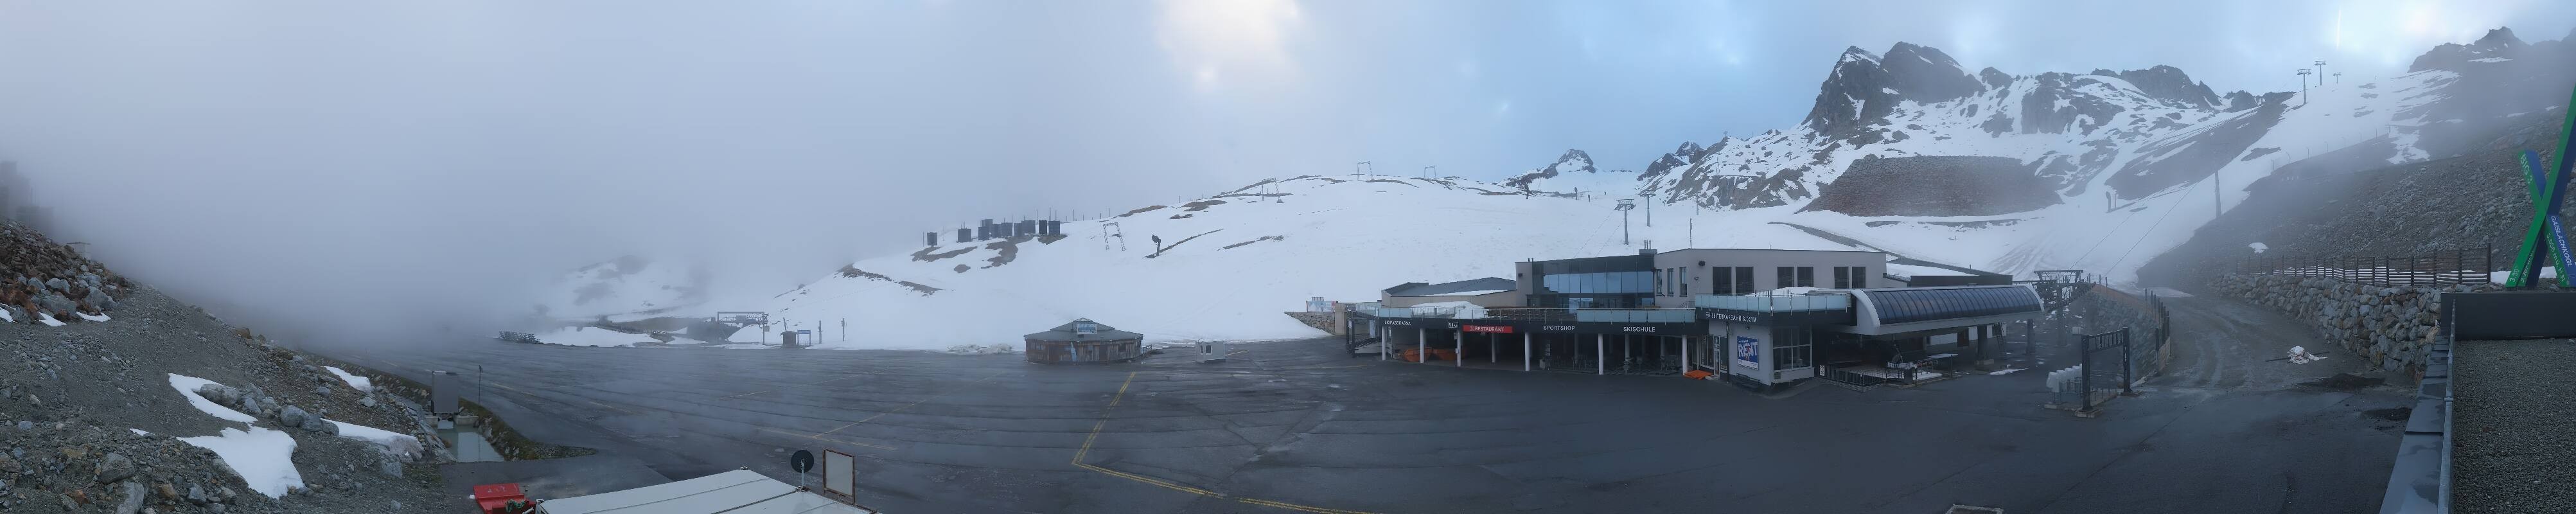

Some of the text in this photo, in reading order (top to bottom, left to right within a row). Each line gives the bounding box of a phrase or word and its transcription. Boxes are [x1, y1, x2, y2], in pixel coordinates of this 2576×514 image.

[2521, 154, 2533, 184] BIG 3
[2551, 216, 2573, 267] GAISLACHKOGL
